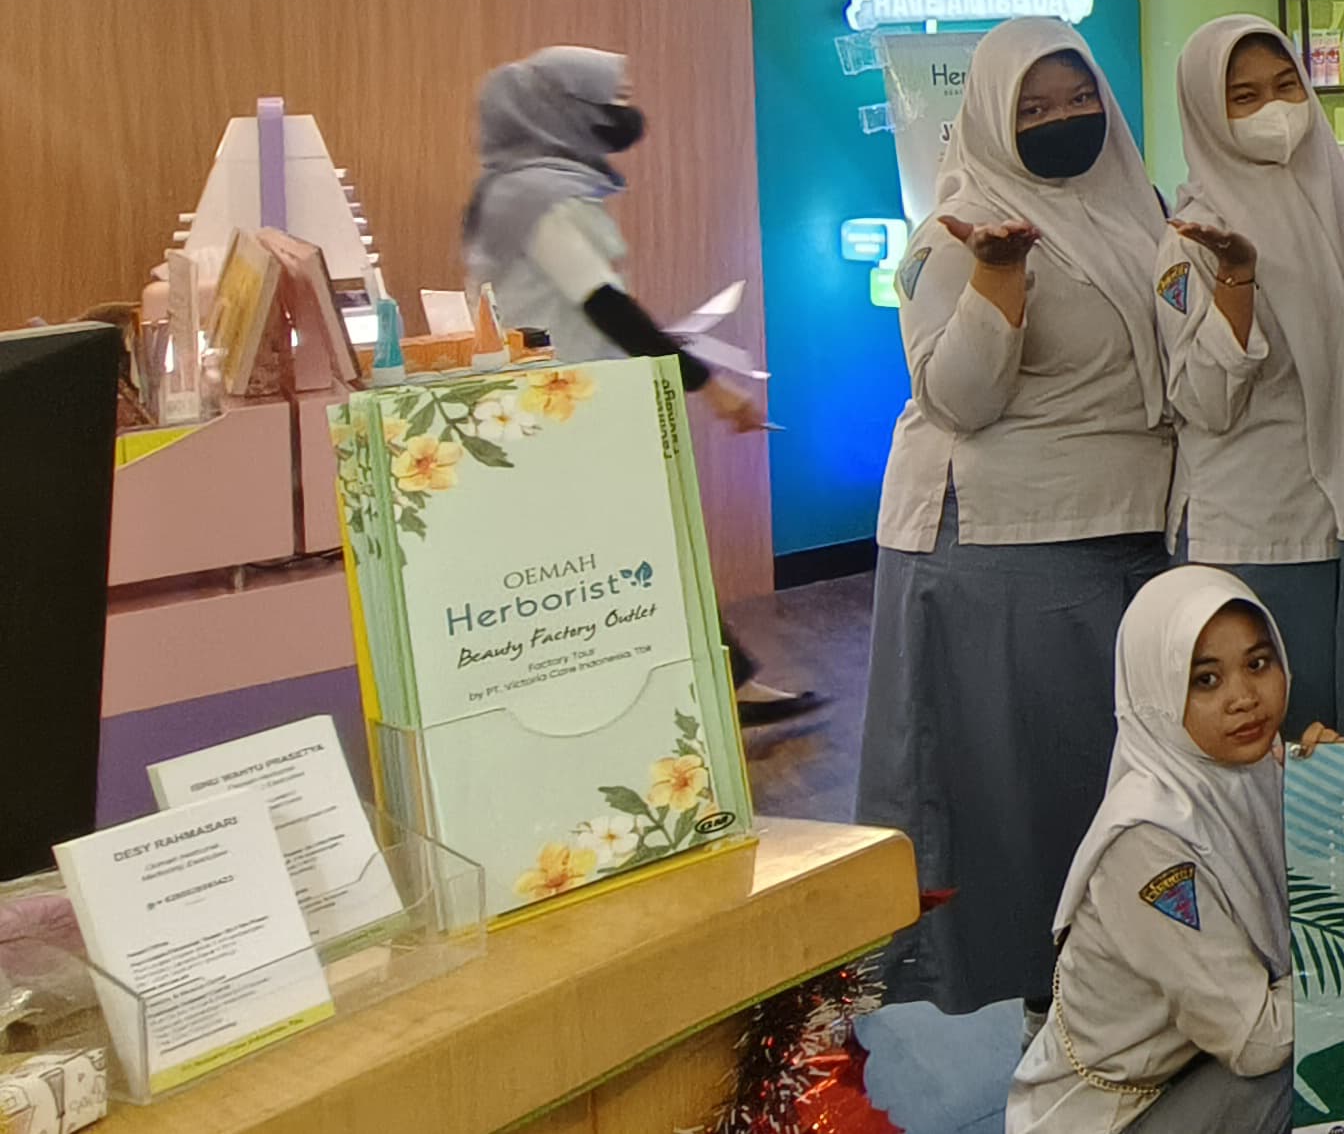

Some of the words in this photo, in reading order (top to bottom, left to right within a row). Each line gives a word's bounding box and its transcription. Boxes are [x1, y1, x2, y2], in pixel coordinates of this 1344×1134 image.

[503, 553, 597, 590] OEMAH
[446, 574, 621, 637] Herborist
[457, 641, 523, 670] Beauty
[530, 623, 597, 649] Factory
[604, 602, 659, 629] Outlet
[468, 691, 484, 702] by
[503, 672, 548, 692] Victoria
[113, 843, 151, 863] DESY
[154, 815, 239, 849] RAHMASARI
